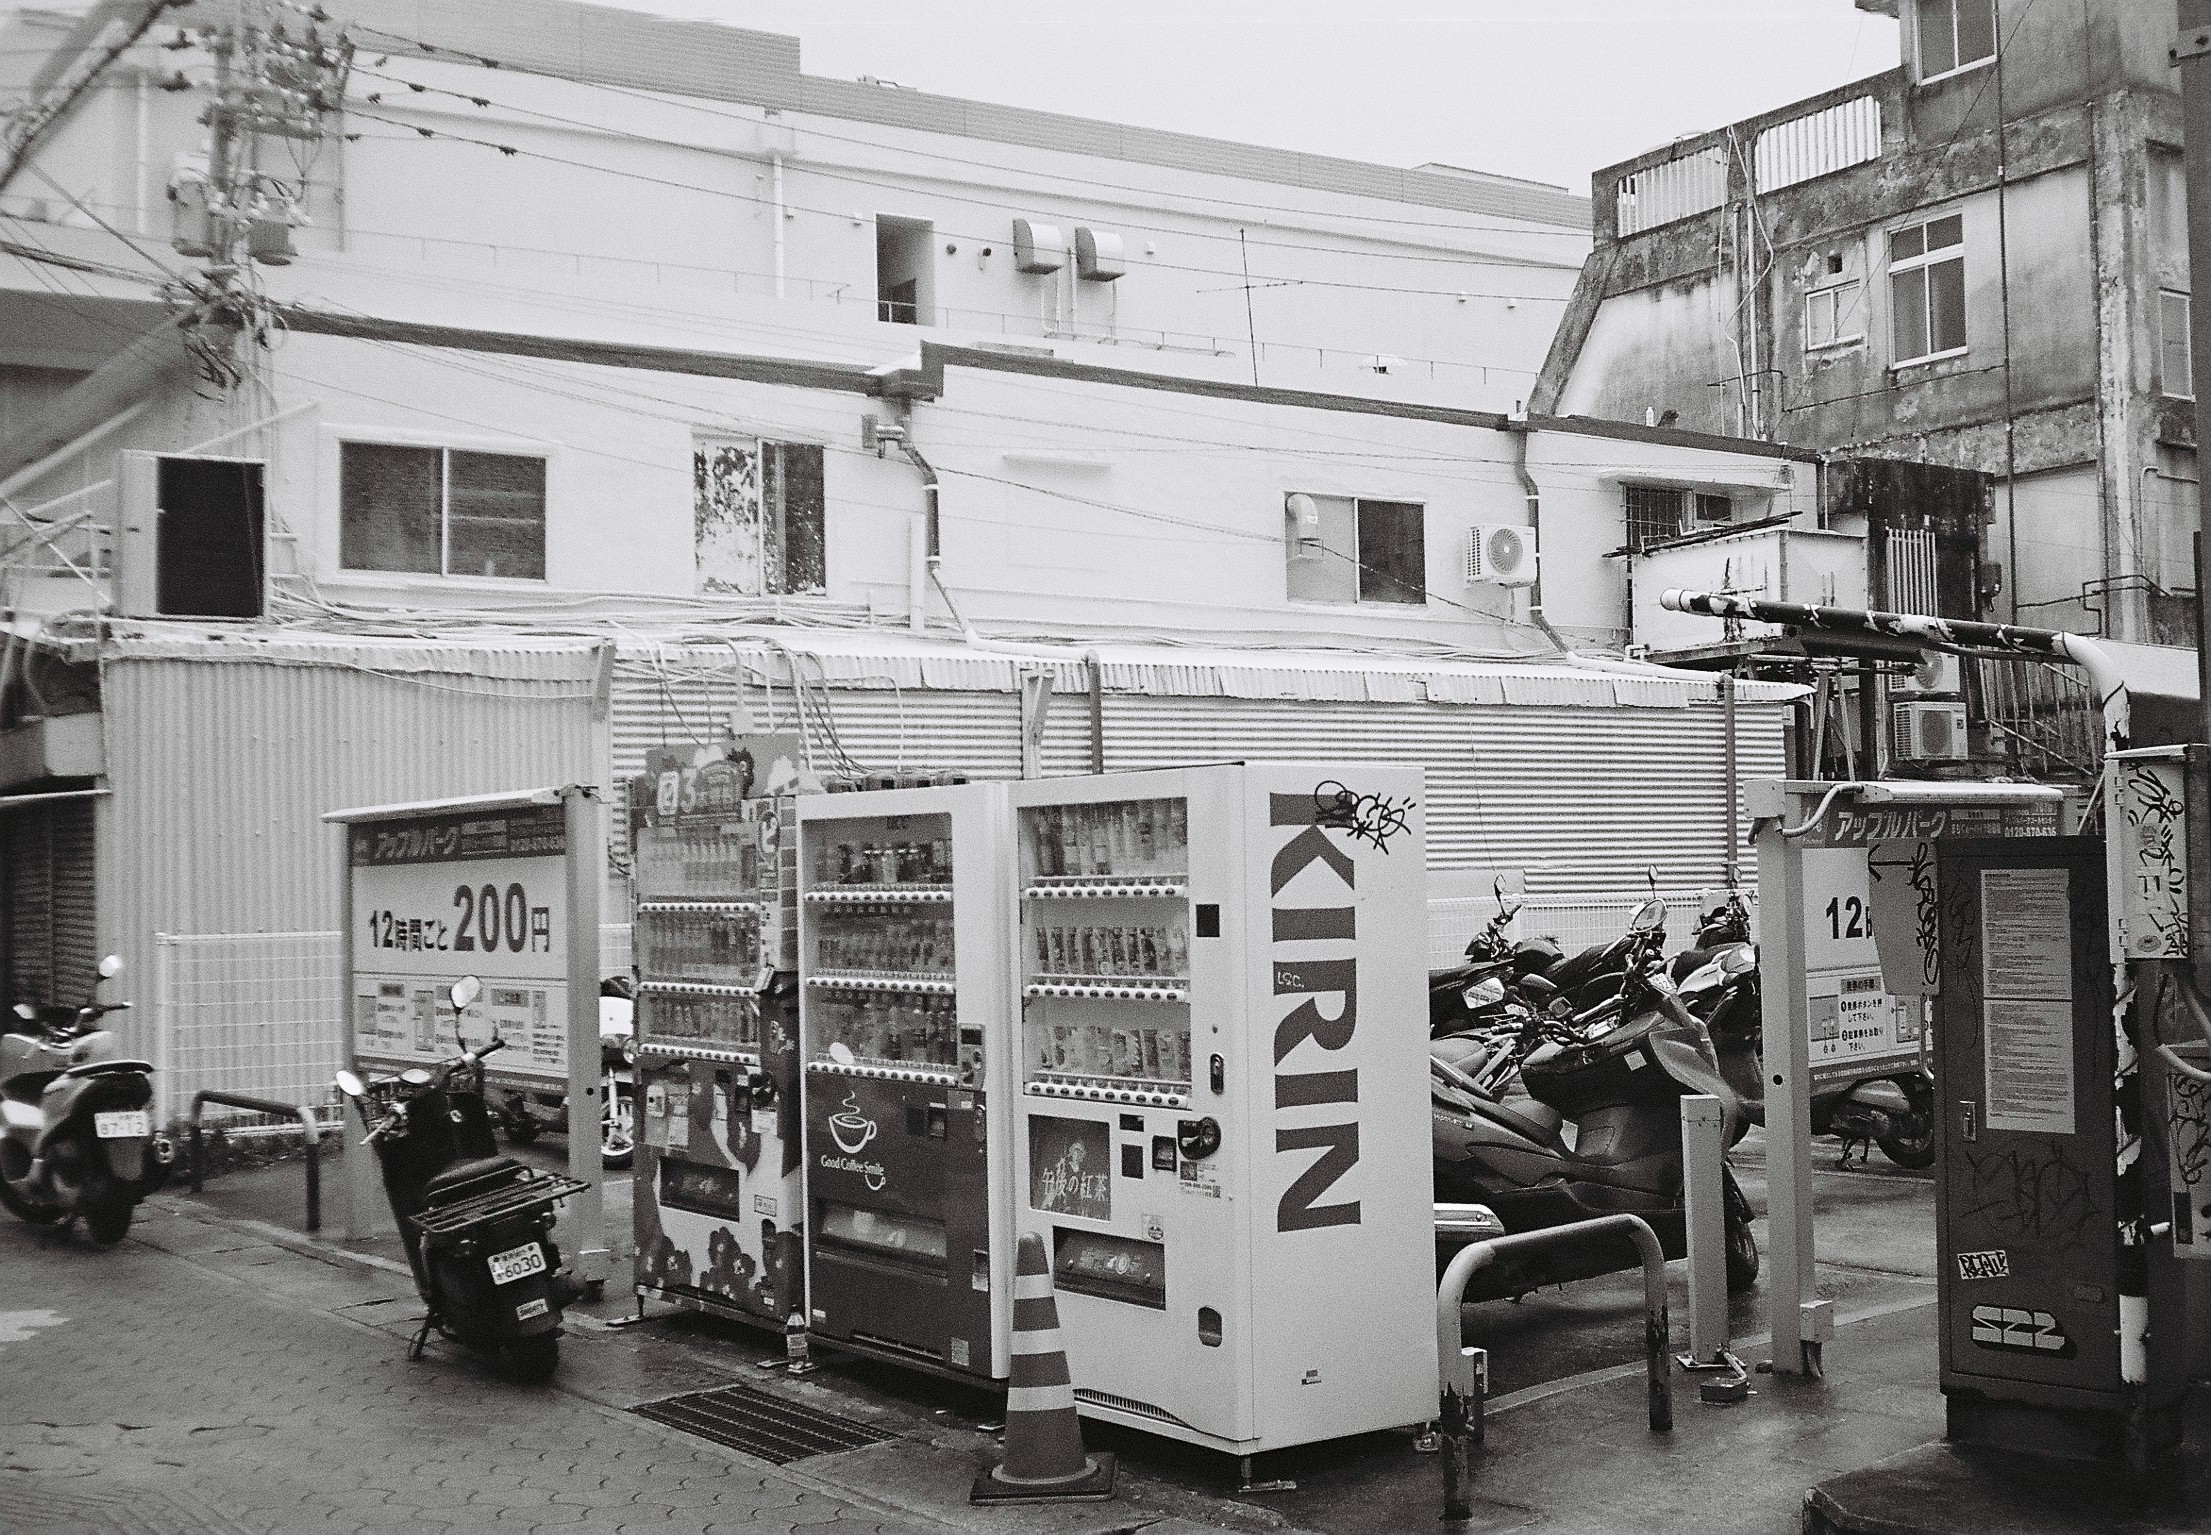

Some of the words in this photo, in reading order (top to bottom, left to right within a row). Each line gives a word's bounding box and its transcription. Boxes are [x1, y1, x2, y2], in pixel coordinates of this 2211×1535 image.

[1835, 808, 1947, 841] アップルパーク
[1270, 792, 1361, 1233] KIRIN
[821, 1154, 840, 1169] Good
[841, 1157, 864, 1174] Coffee
[1042, 1157, 1108, 1201] 午後の紅茶
